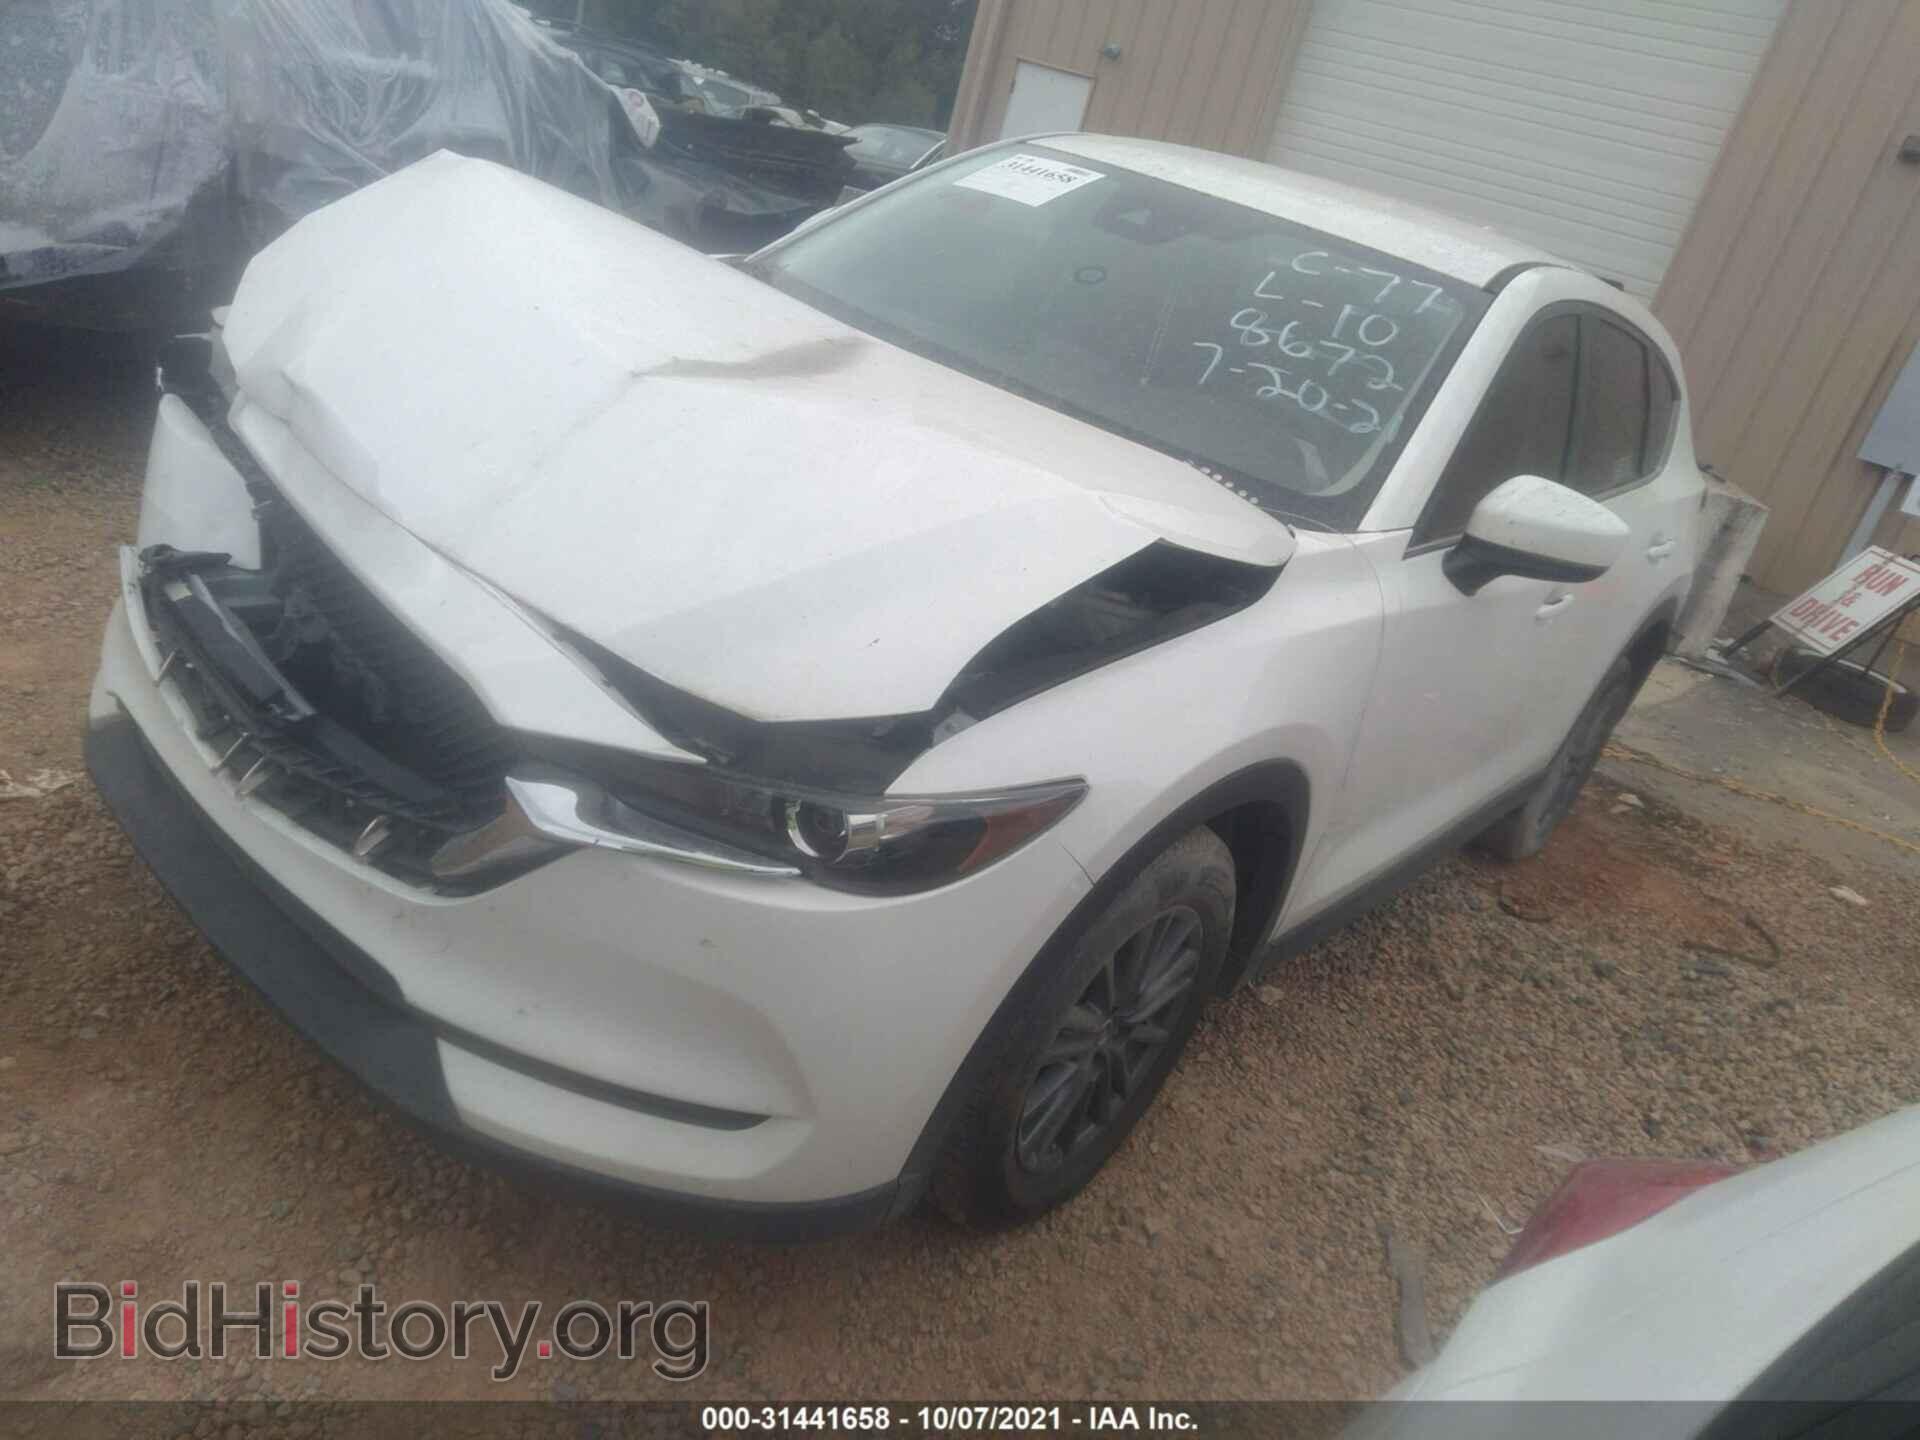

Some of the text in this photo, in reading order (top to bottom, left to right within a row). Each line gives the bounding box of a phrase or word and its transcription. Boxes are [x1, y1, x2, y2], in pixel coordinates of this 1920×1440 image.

[1254, 271, 1398, 347] L-10
[1290, 251, 1444, 314] C-77
[1230, 307, 1404, 392] 8672
[1852, 564, 1910, 597] RUN
[1790, 597, 1860, 641] DRIVE
